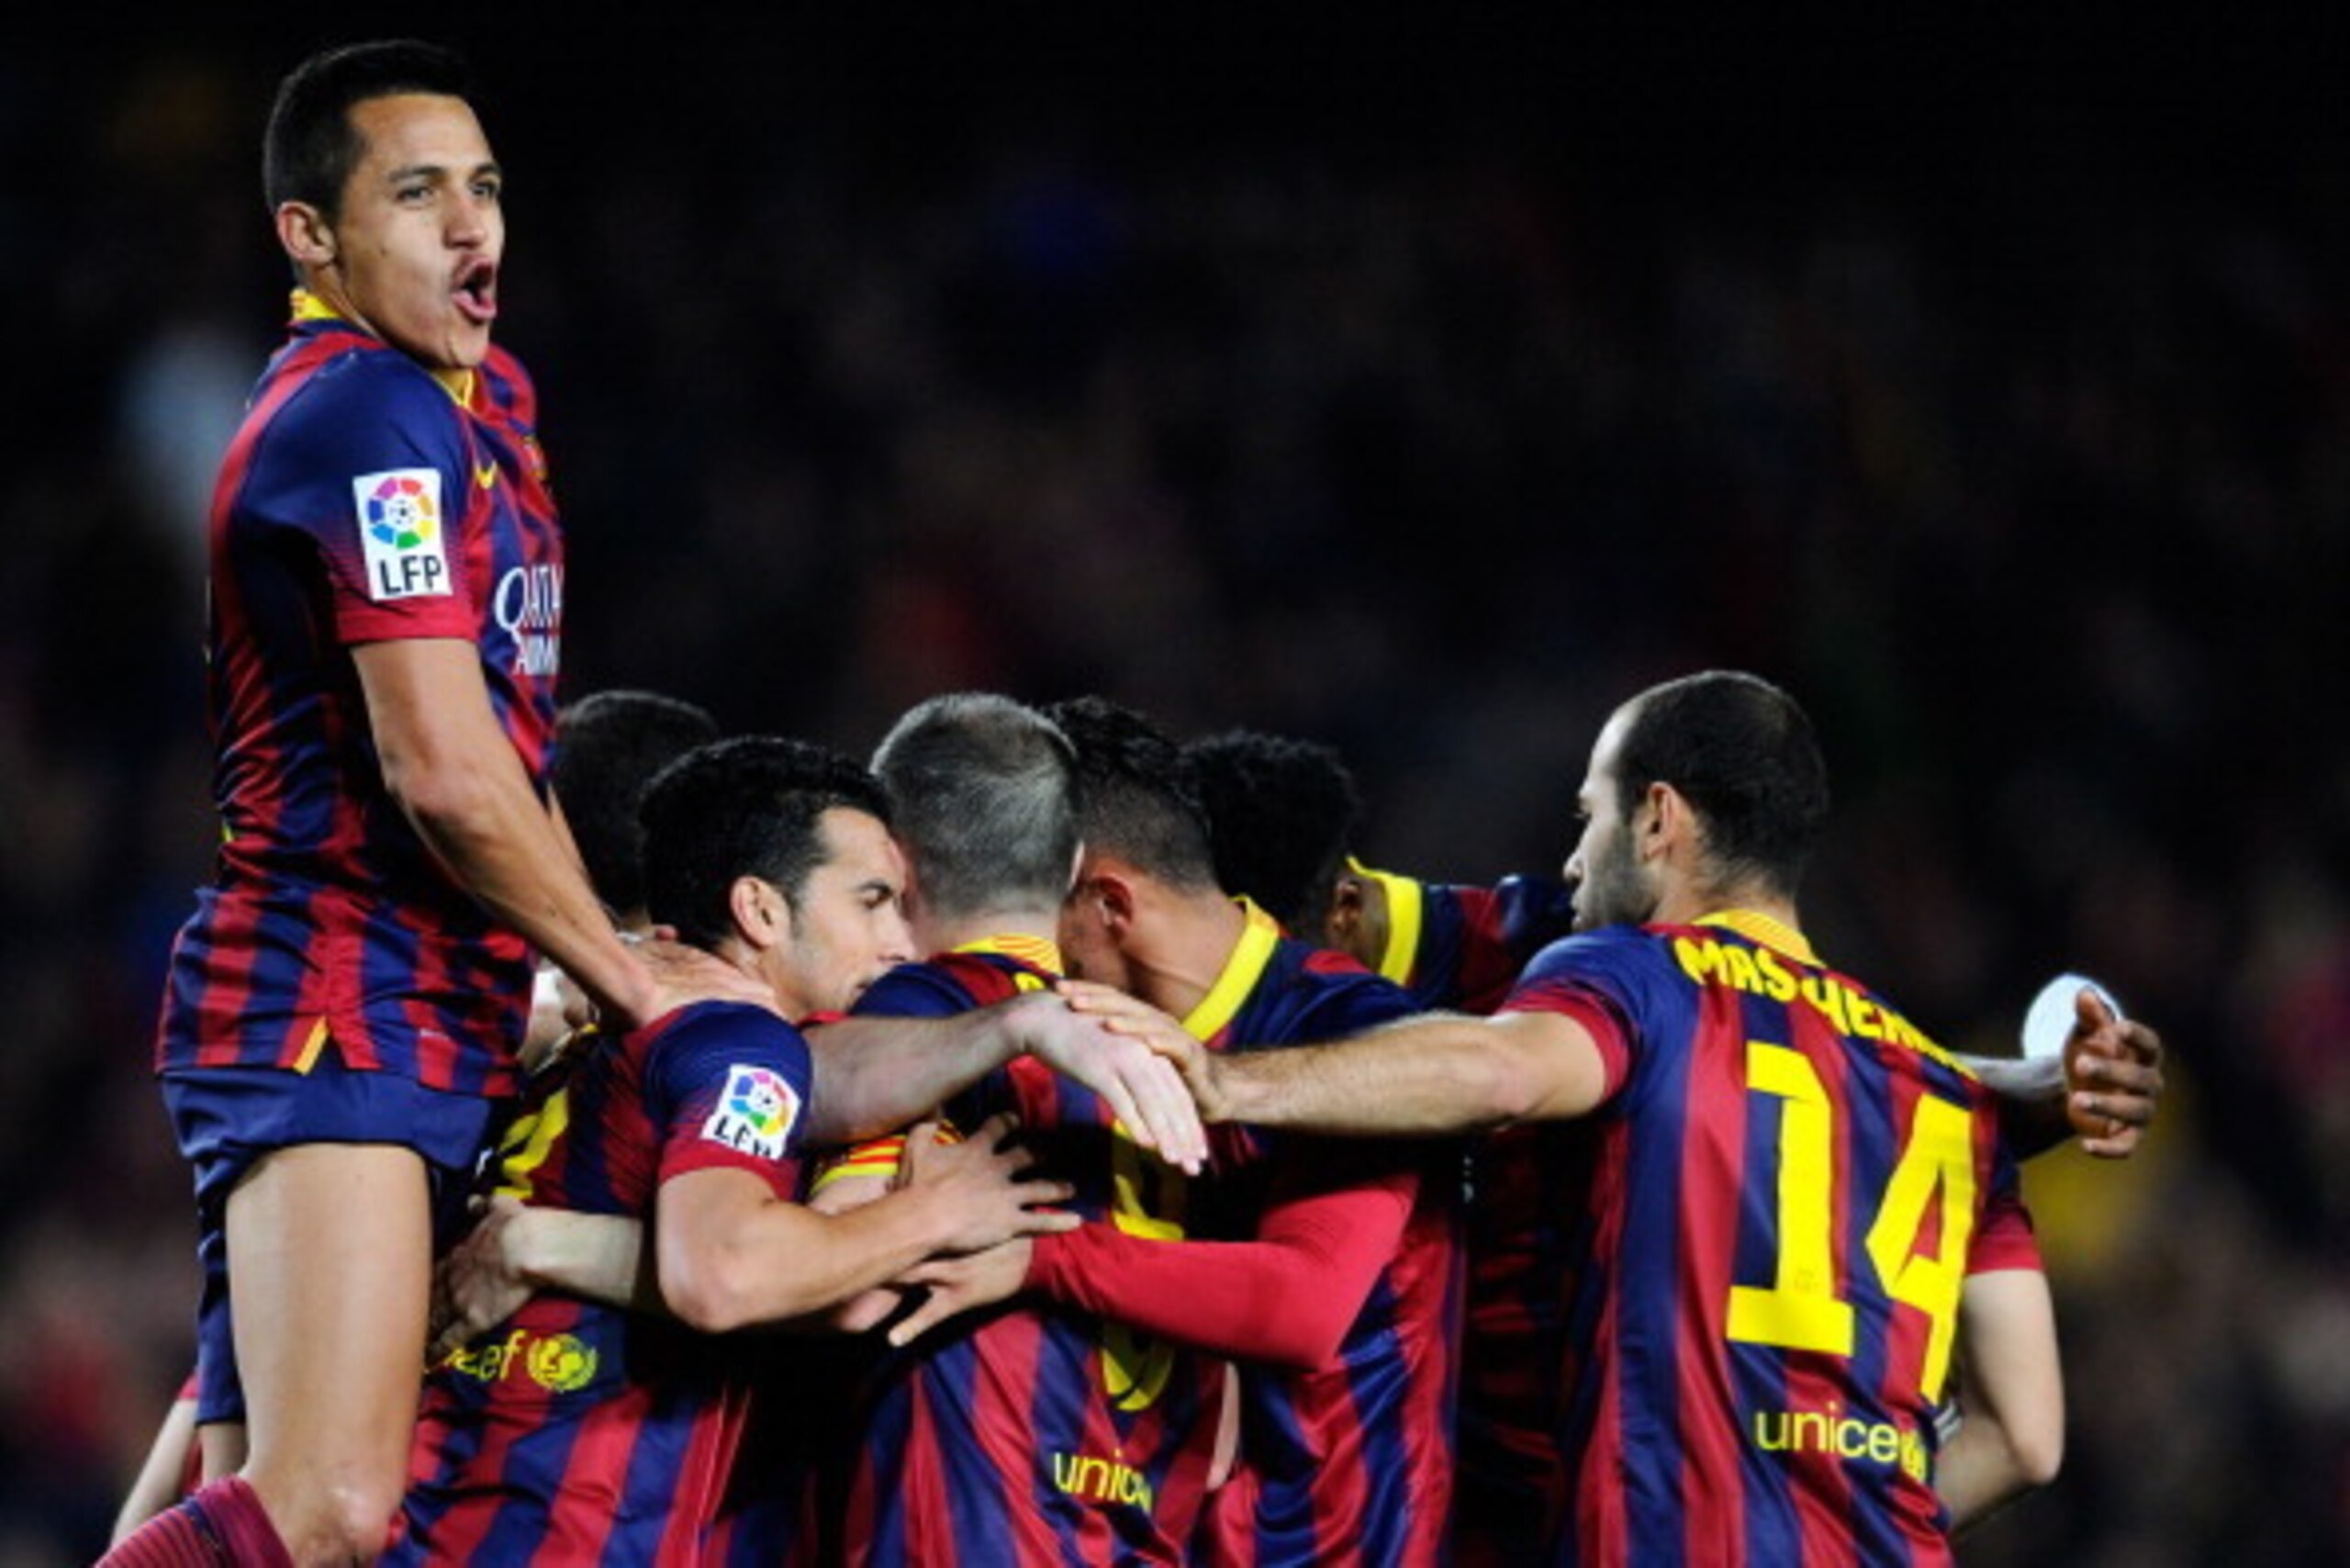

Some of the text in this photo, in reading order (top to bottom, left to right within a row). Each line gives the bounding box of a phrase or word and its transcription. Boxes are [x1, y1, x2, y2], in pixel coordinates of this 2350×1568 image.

[379, 554, 442, 596] LFP
[1727, 1040, 1975, 1406] 14
[1754, 1401, 1908, 1469] unice
[1055, 1448, 1152, 1517] unic
